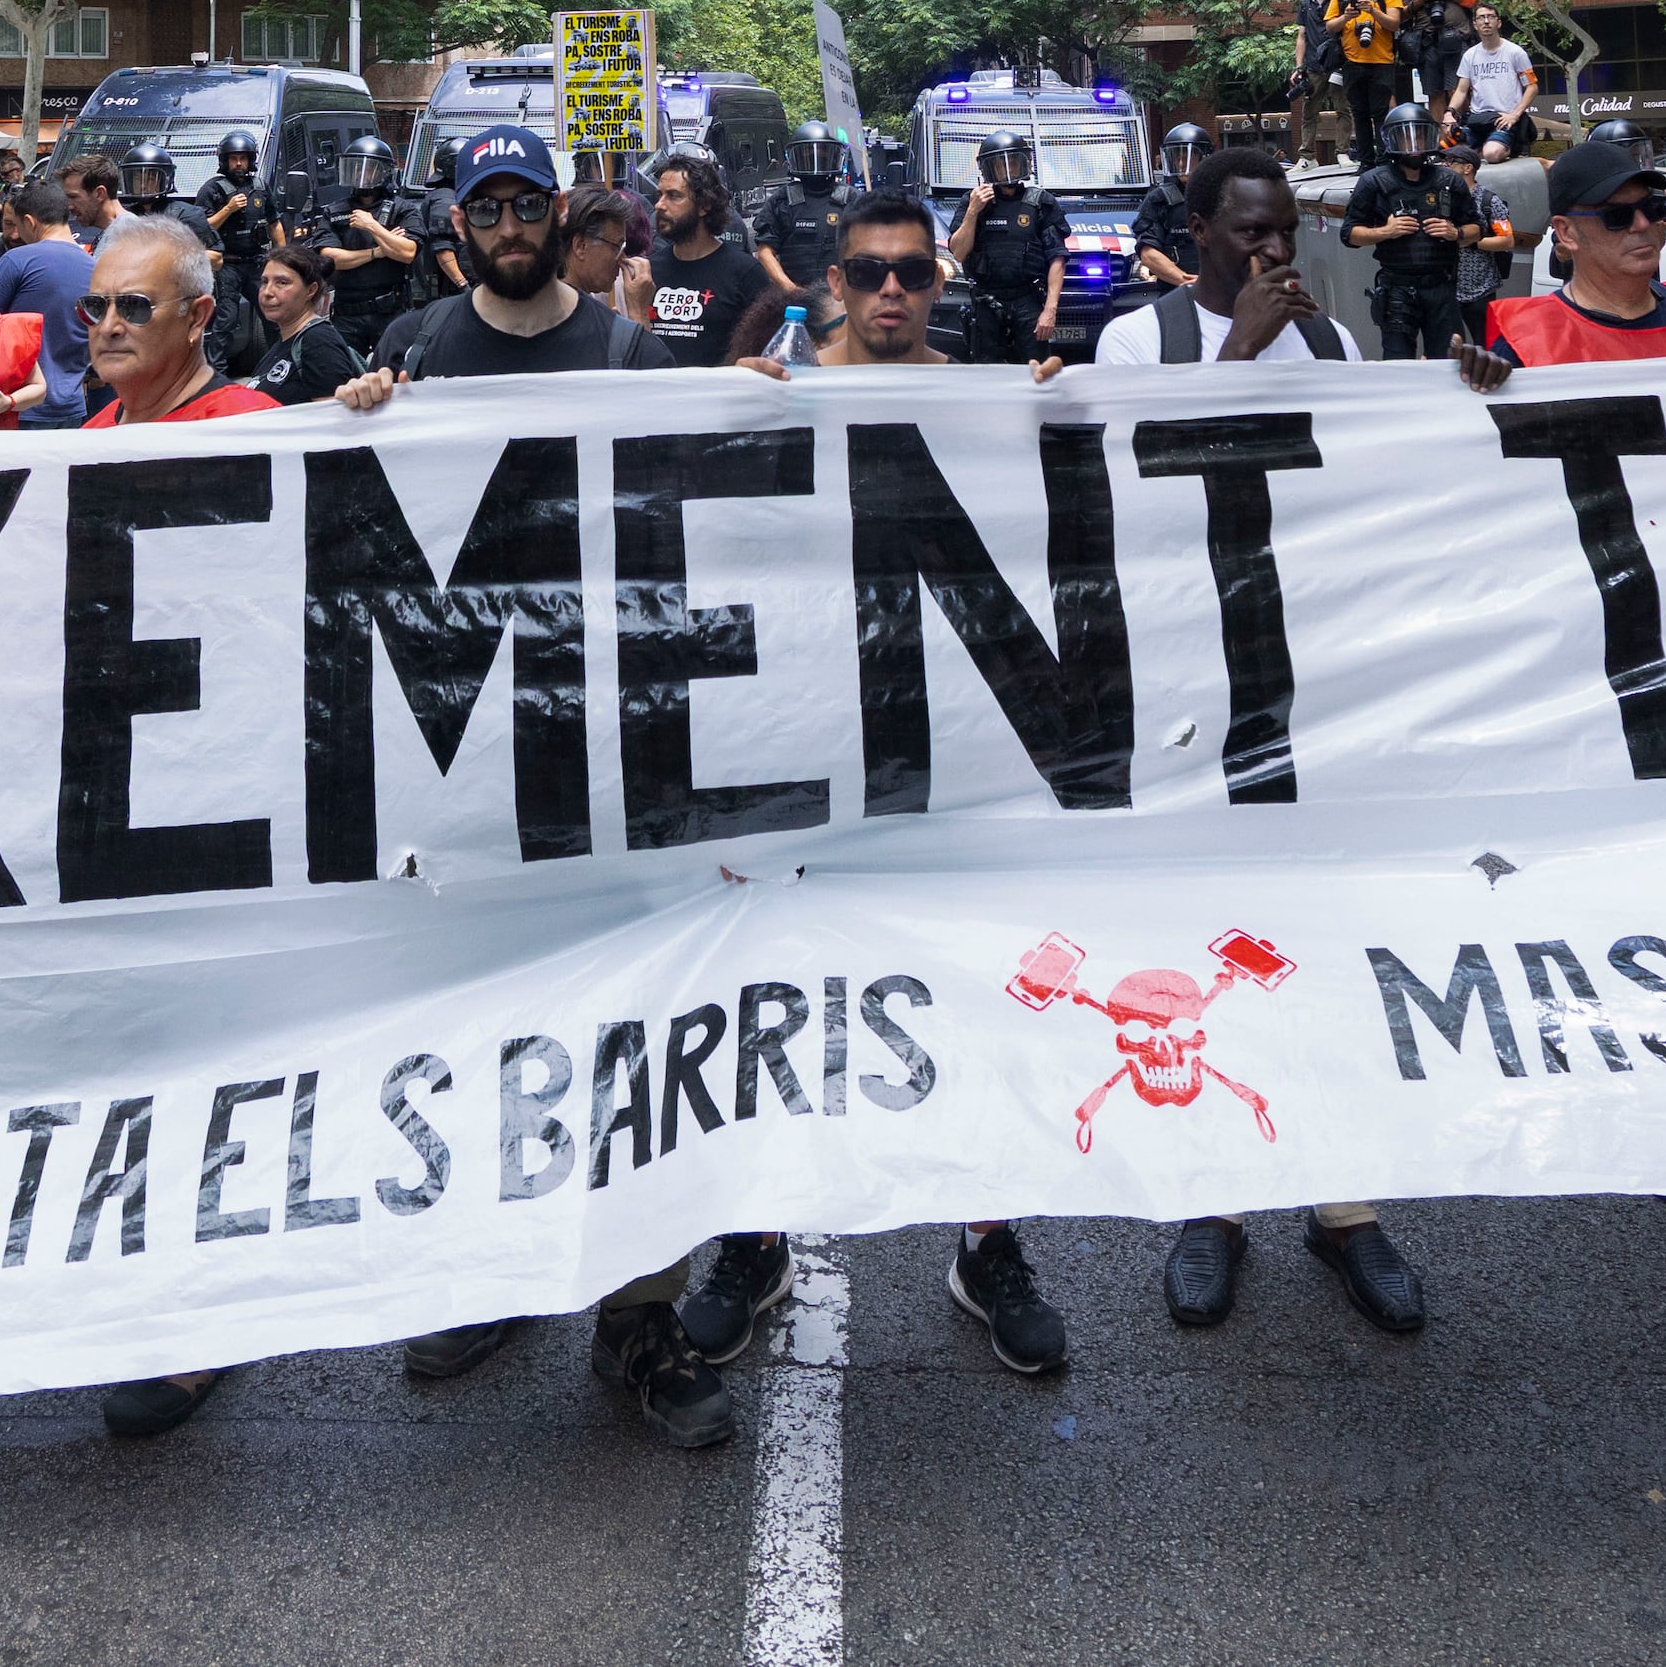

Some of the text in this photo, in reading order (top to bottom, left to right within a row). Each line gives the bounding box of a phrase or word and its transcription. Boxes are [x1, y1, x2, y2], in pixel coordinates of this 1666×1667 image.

[565, 15, 621, 30] EL TURISME
[590, 29, 640, 43] ENS ROBA
[583, 44, 622, 58] SOSTRE
[608, 58, 642, 71] FUTUR
[40, 96, 78, 108] resco
[567, 94, 623, 108] EL TURISME
[1581, 96, 1633, 116] Calidad
[593, 108, 642, 122] ENS ROBA
[585, 123, 623, 135] SOSTRE
[610, 137, 643, 150] FUTUR
[473, 137, 526, 166] FILA
[1068, 223, 1112, 234] olicia
[194, 1052, 454, 1244] ELS
[498, 975, 936, 1204] BARRIS
